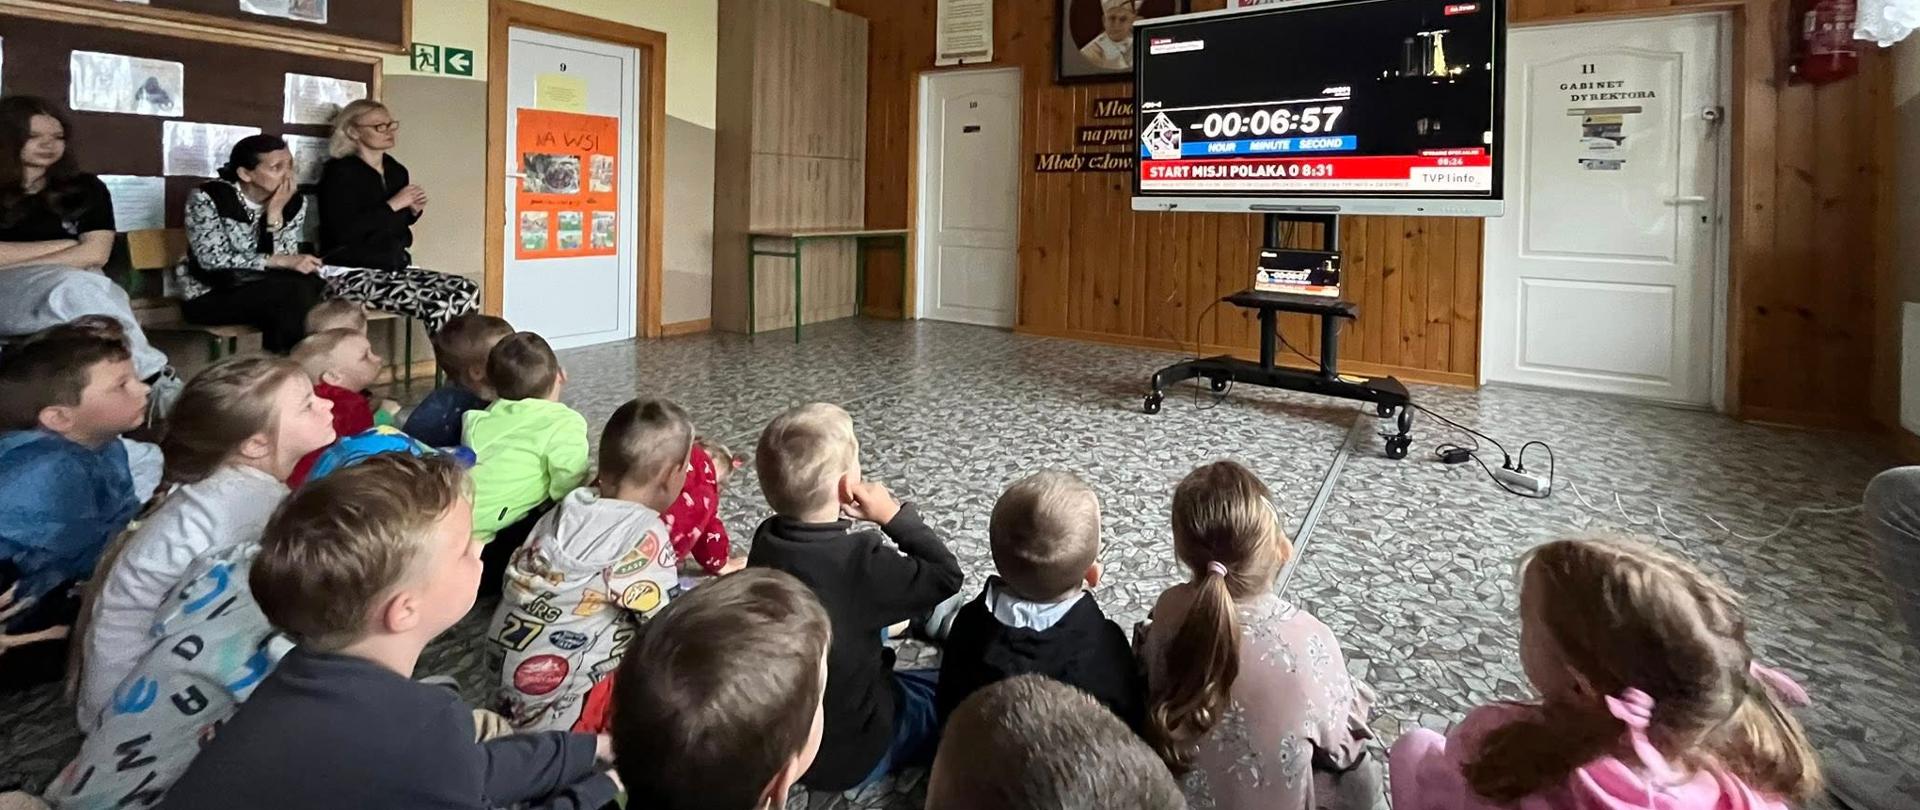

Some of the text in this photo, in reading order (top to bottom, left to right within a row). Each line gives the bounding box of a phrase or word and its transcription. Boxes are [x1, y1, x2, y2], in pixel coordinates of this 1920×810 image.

[559, 62, 567, 72] 9
[1582, 63, 1595, 74] 11
[1560, 81, 1625, 91] GABINET
[1571, 91, 1656, 102] DYREKTORA
[1190, 106, 1343, 137] -00:06:57
[1082, 130, 1101, 142] na
[1208, 138, 1342, 154] HOUR MINUTE SECOND
[1037, 153, 1086, 172] Młody
[1150, 165, 1190, 178] START
[1192, 165, 1228, 178] MISJI
[1230, 164, 1286, 177] POLAKA
[1302, 164, 1333, 176] 8:31
[498, 612, 545, 652] 27
